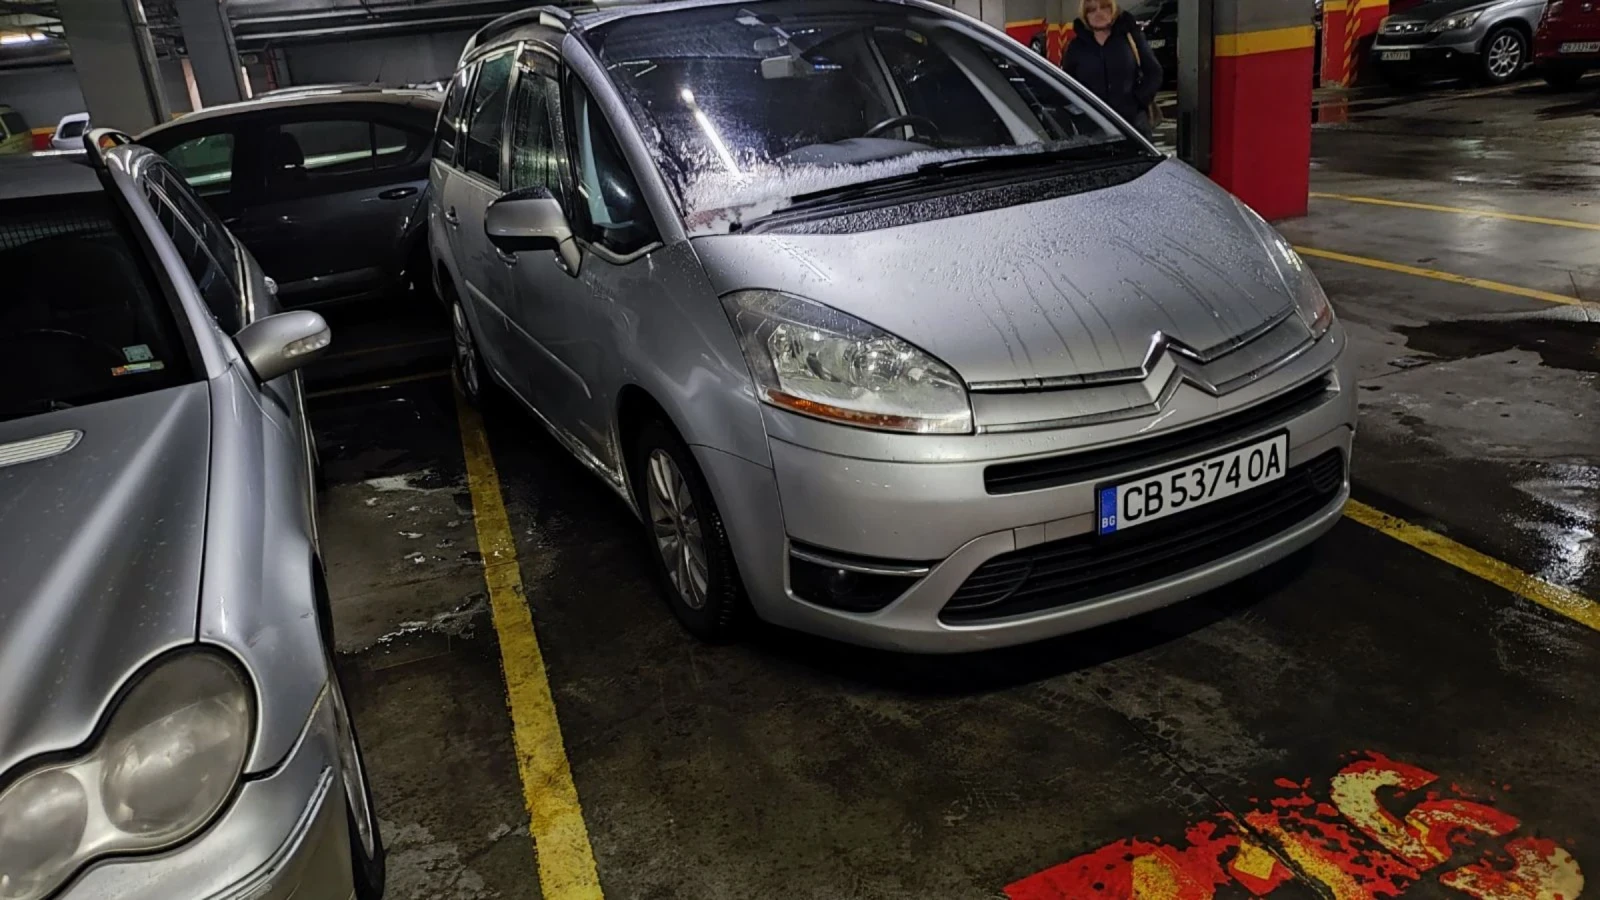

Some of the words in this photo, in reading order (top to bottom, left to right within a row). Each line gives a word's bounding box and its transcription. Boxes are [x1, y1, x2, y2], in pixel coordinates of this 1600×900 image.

[1123, 480, 1164, 521] CB
[1170, 455, 1241, 508] 5374
[1248, 442, 1281, 482] OA
[1101, 515, 1116, 529] BG
